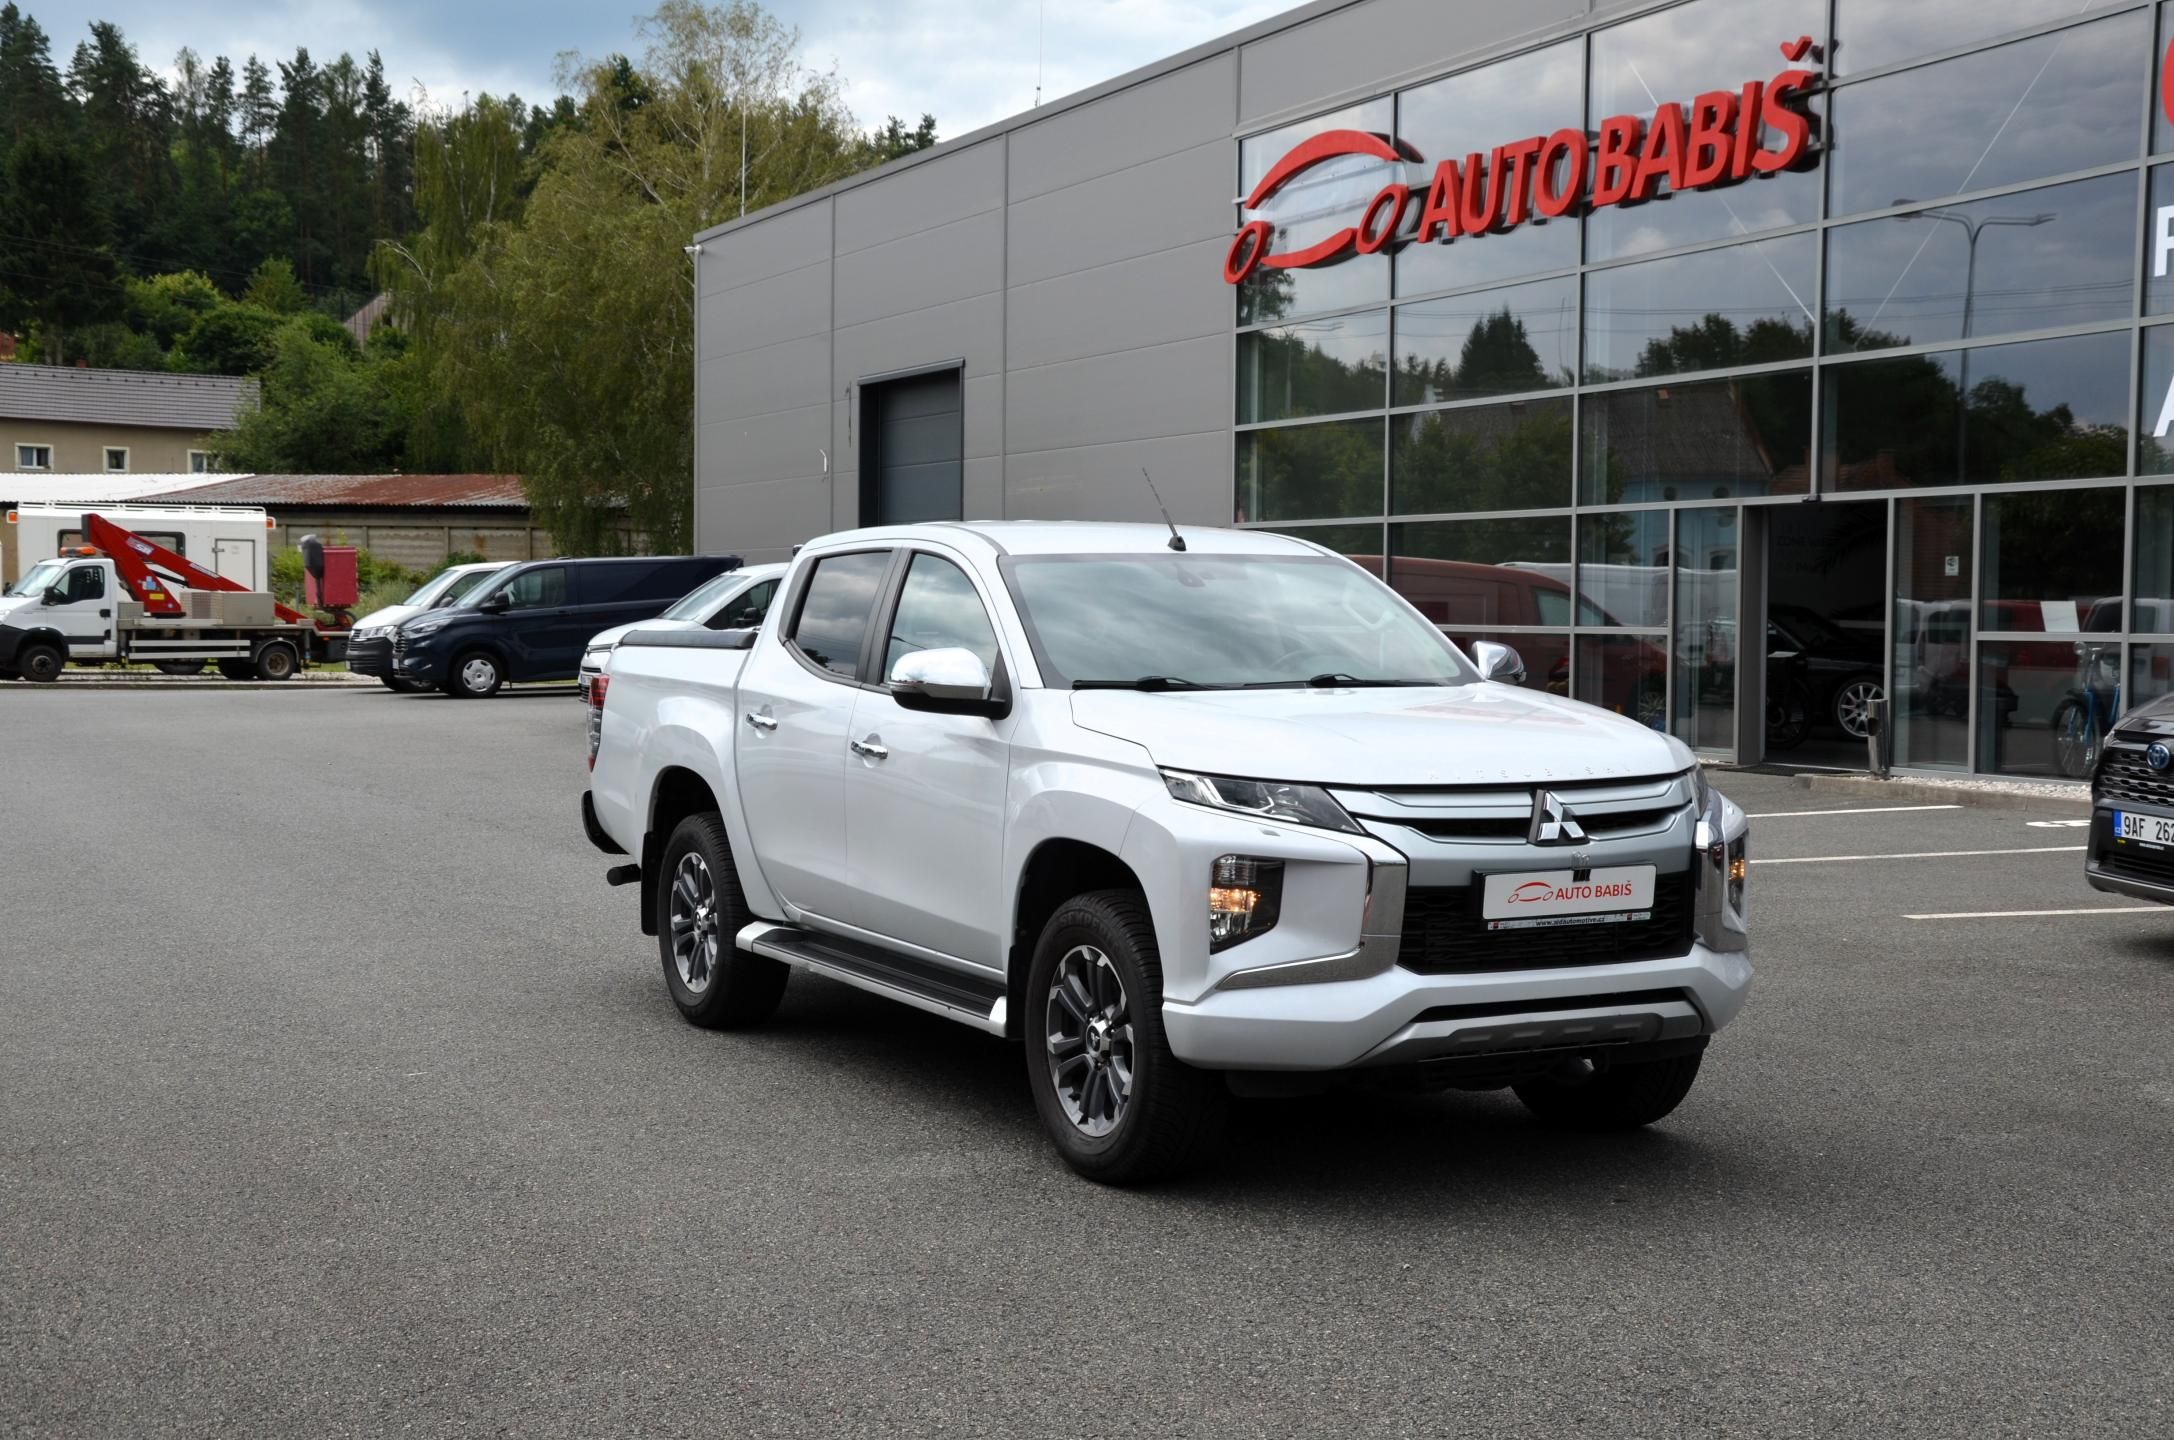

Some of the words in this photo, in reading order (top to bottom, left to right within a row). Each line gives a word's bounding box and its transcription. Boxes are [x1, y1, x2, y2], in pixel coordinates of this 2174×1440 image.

[1417, 126, 1588, 244] AUTO
[1592, 36, 1820, 208] BABIŠ
[2124, 816, 2145, 837] 9AF
[1555, 886, 1592, 901] AUTO
[1595, 880, 1632, 898] BABIŠ
